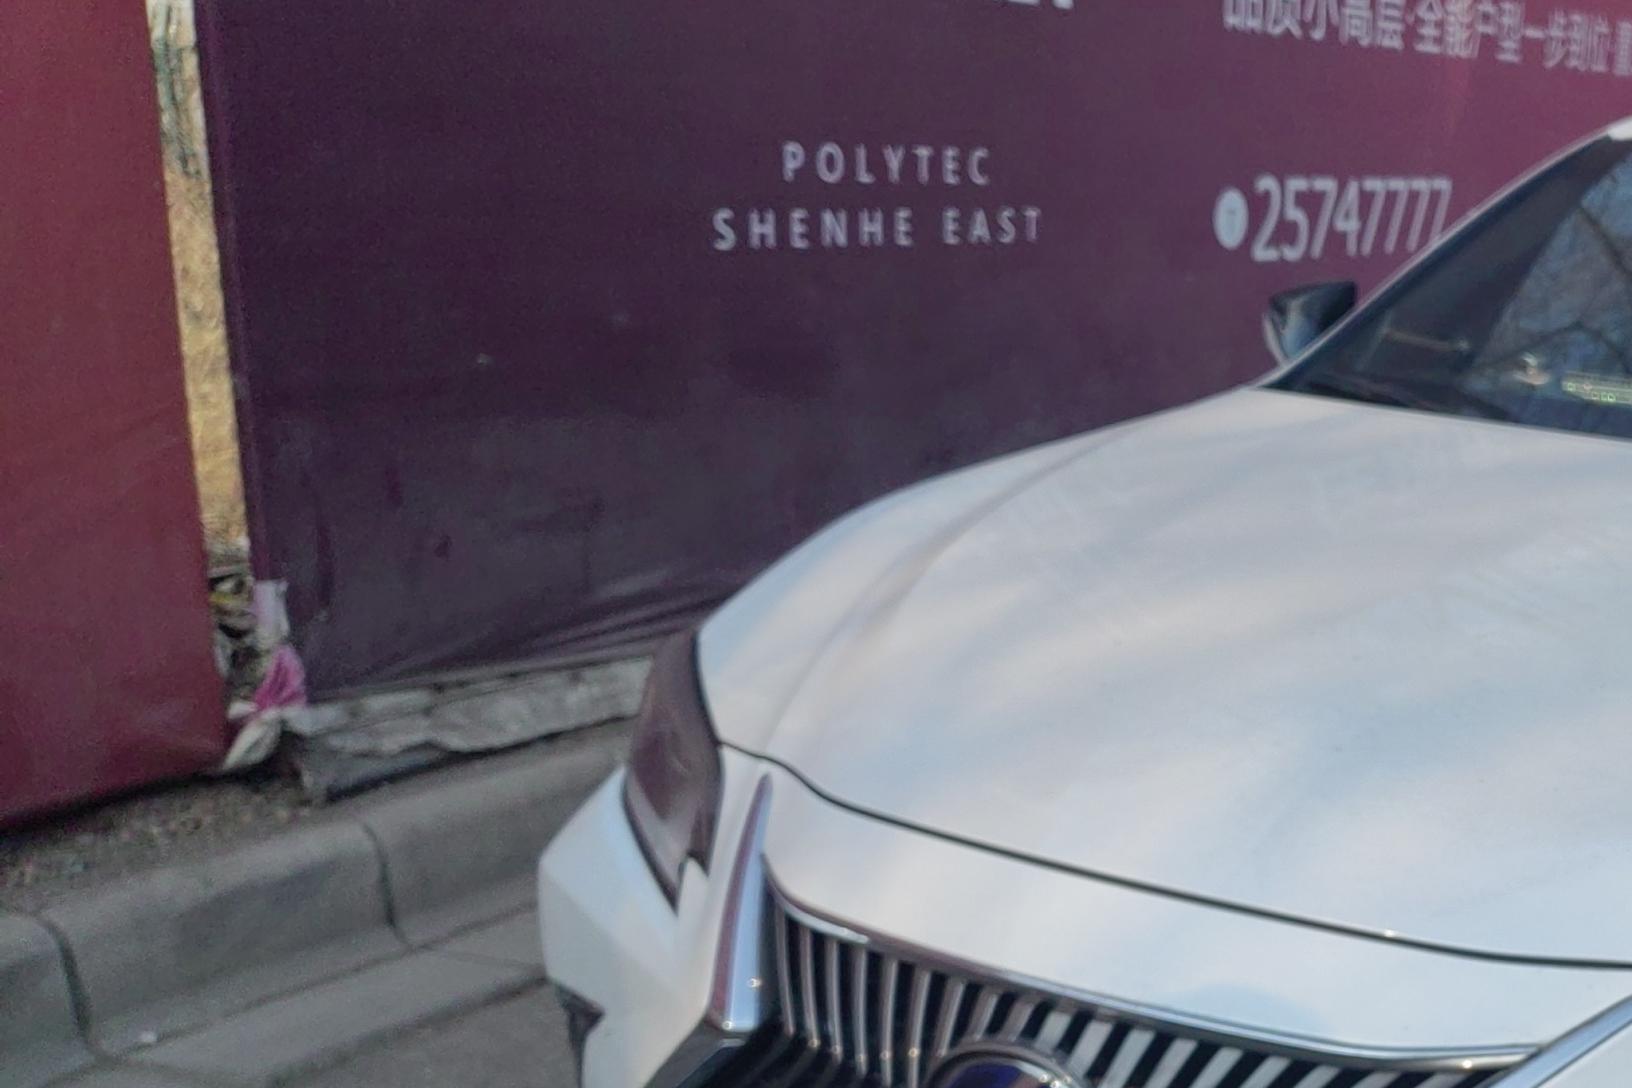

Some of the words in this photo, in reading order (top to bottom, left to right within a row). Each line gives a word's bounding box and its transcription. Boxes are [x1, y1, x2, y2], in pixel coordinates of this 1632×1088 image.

[781, 141, 990, 185] POLYTEC
[712, 206, 914, 250] SHENHE
[941, 205, 1042, 245] EAST
[1253, 174, 1453, 262] 25747777
